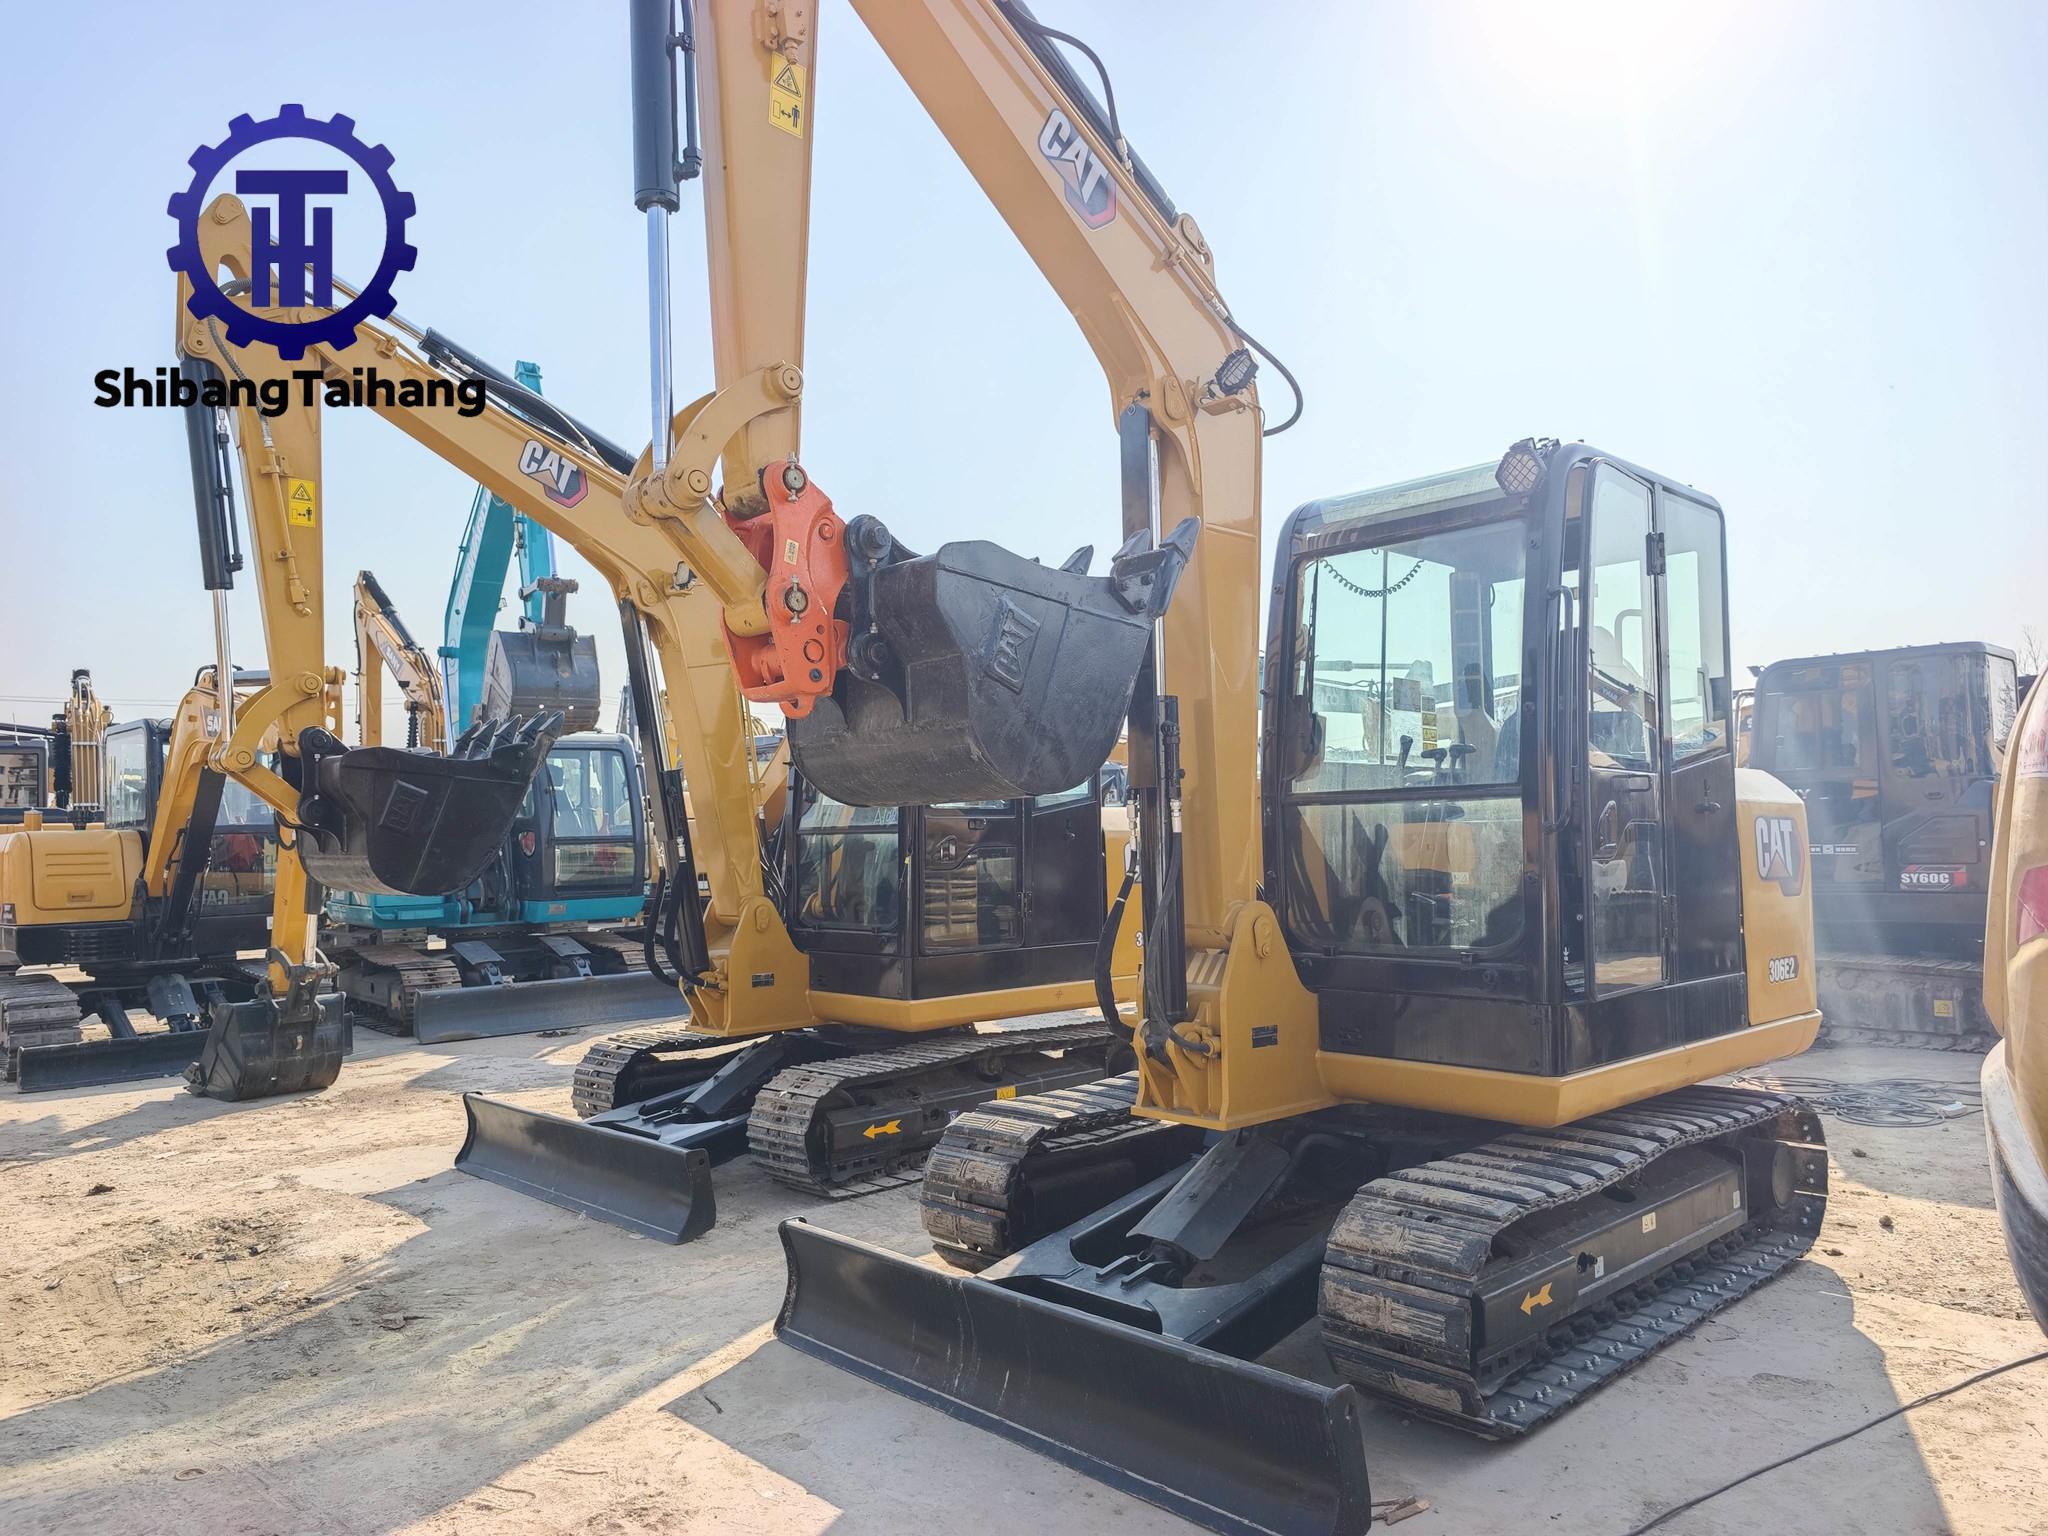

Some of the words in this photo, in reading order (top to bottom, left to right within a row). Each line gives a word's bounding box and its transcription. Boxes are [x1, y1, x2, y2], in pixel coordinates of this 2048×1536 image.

[1039, 109, 1109, 204] CAT
[519, 439, 578, 494] CAT
[1755, 817, 1793, 878] CAT
[1900, 872, 1950, 884] SY60C
[1768, 956, 1796, 983] 306E2
